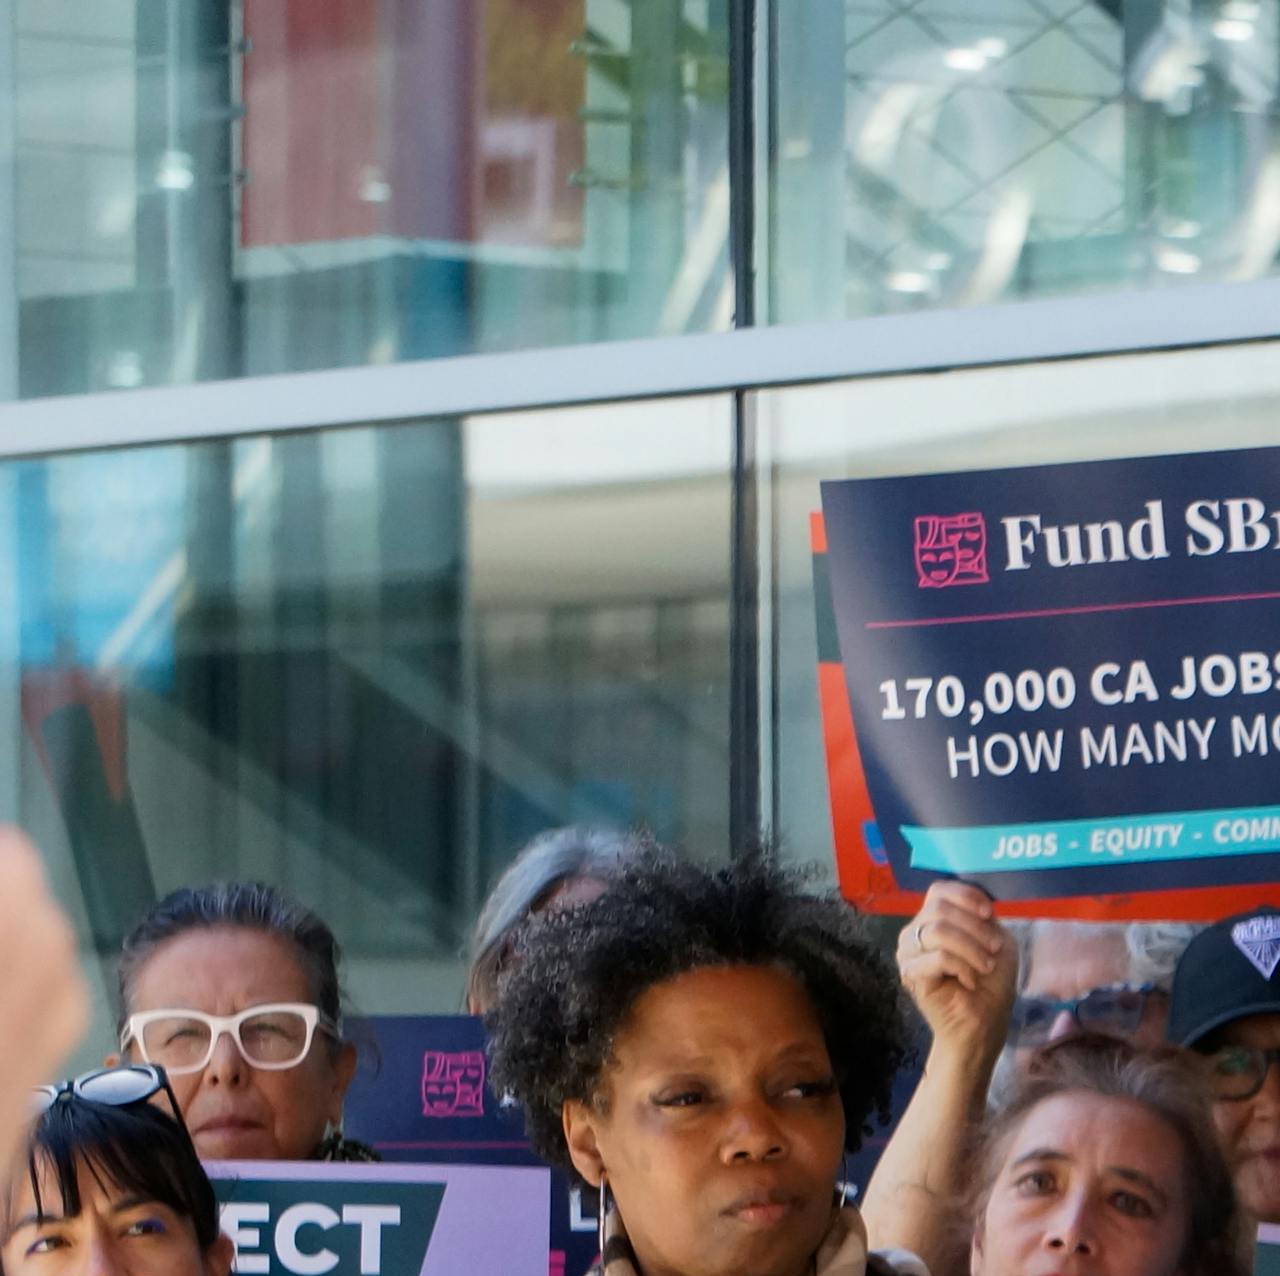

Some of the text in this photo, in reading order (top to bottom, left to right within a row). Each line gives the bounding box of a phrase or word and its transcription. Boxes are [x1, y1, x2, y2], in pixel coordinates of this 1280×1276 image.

[1000, 500, 1171, 572] Fund
[879, 668, 1077, 726] 170,000
[1090, 658, 1159, 706] CA
[946, 729, 1065, 780] HOW
[1081, 717, 1217, 769] MANY
[991, 832, 1058, 862] JOBS
[1090, 823, 1183, 856] EQUITY
[222, 1202, 401, 1276] ECT
